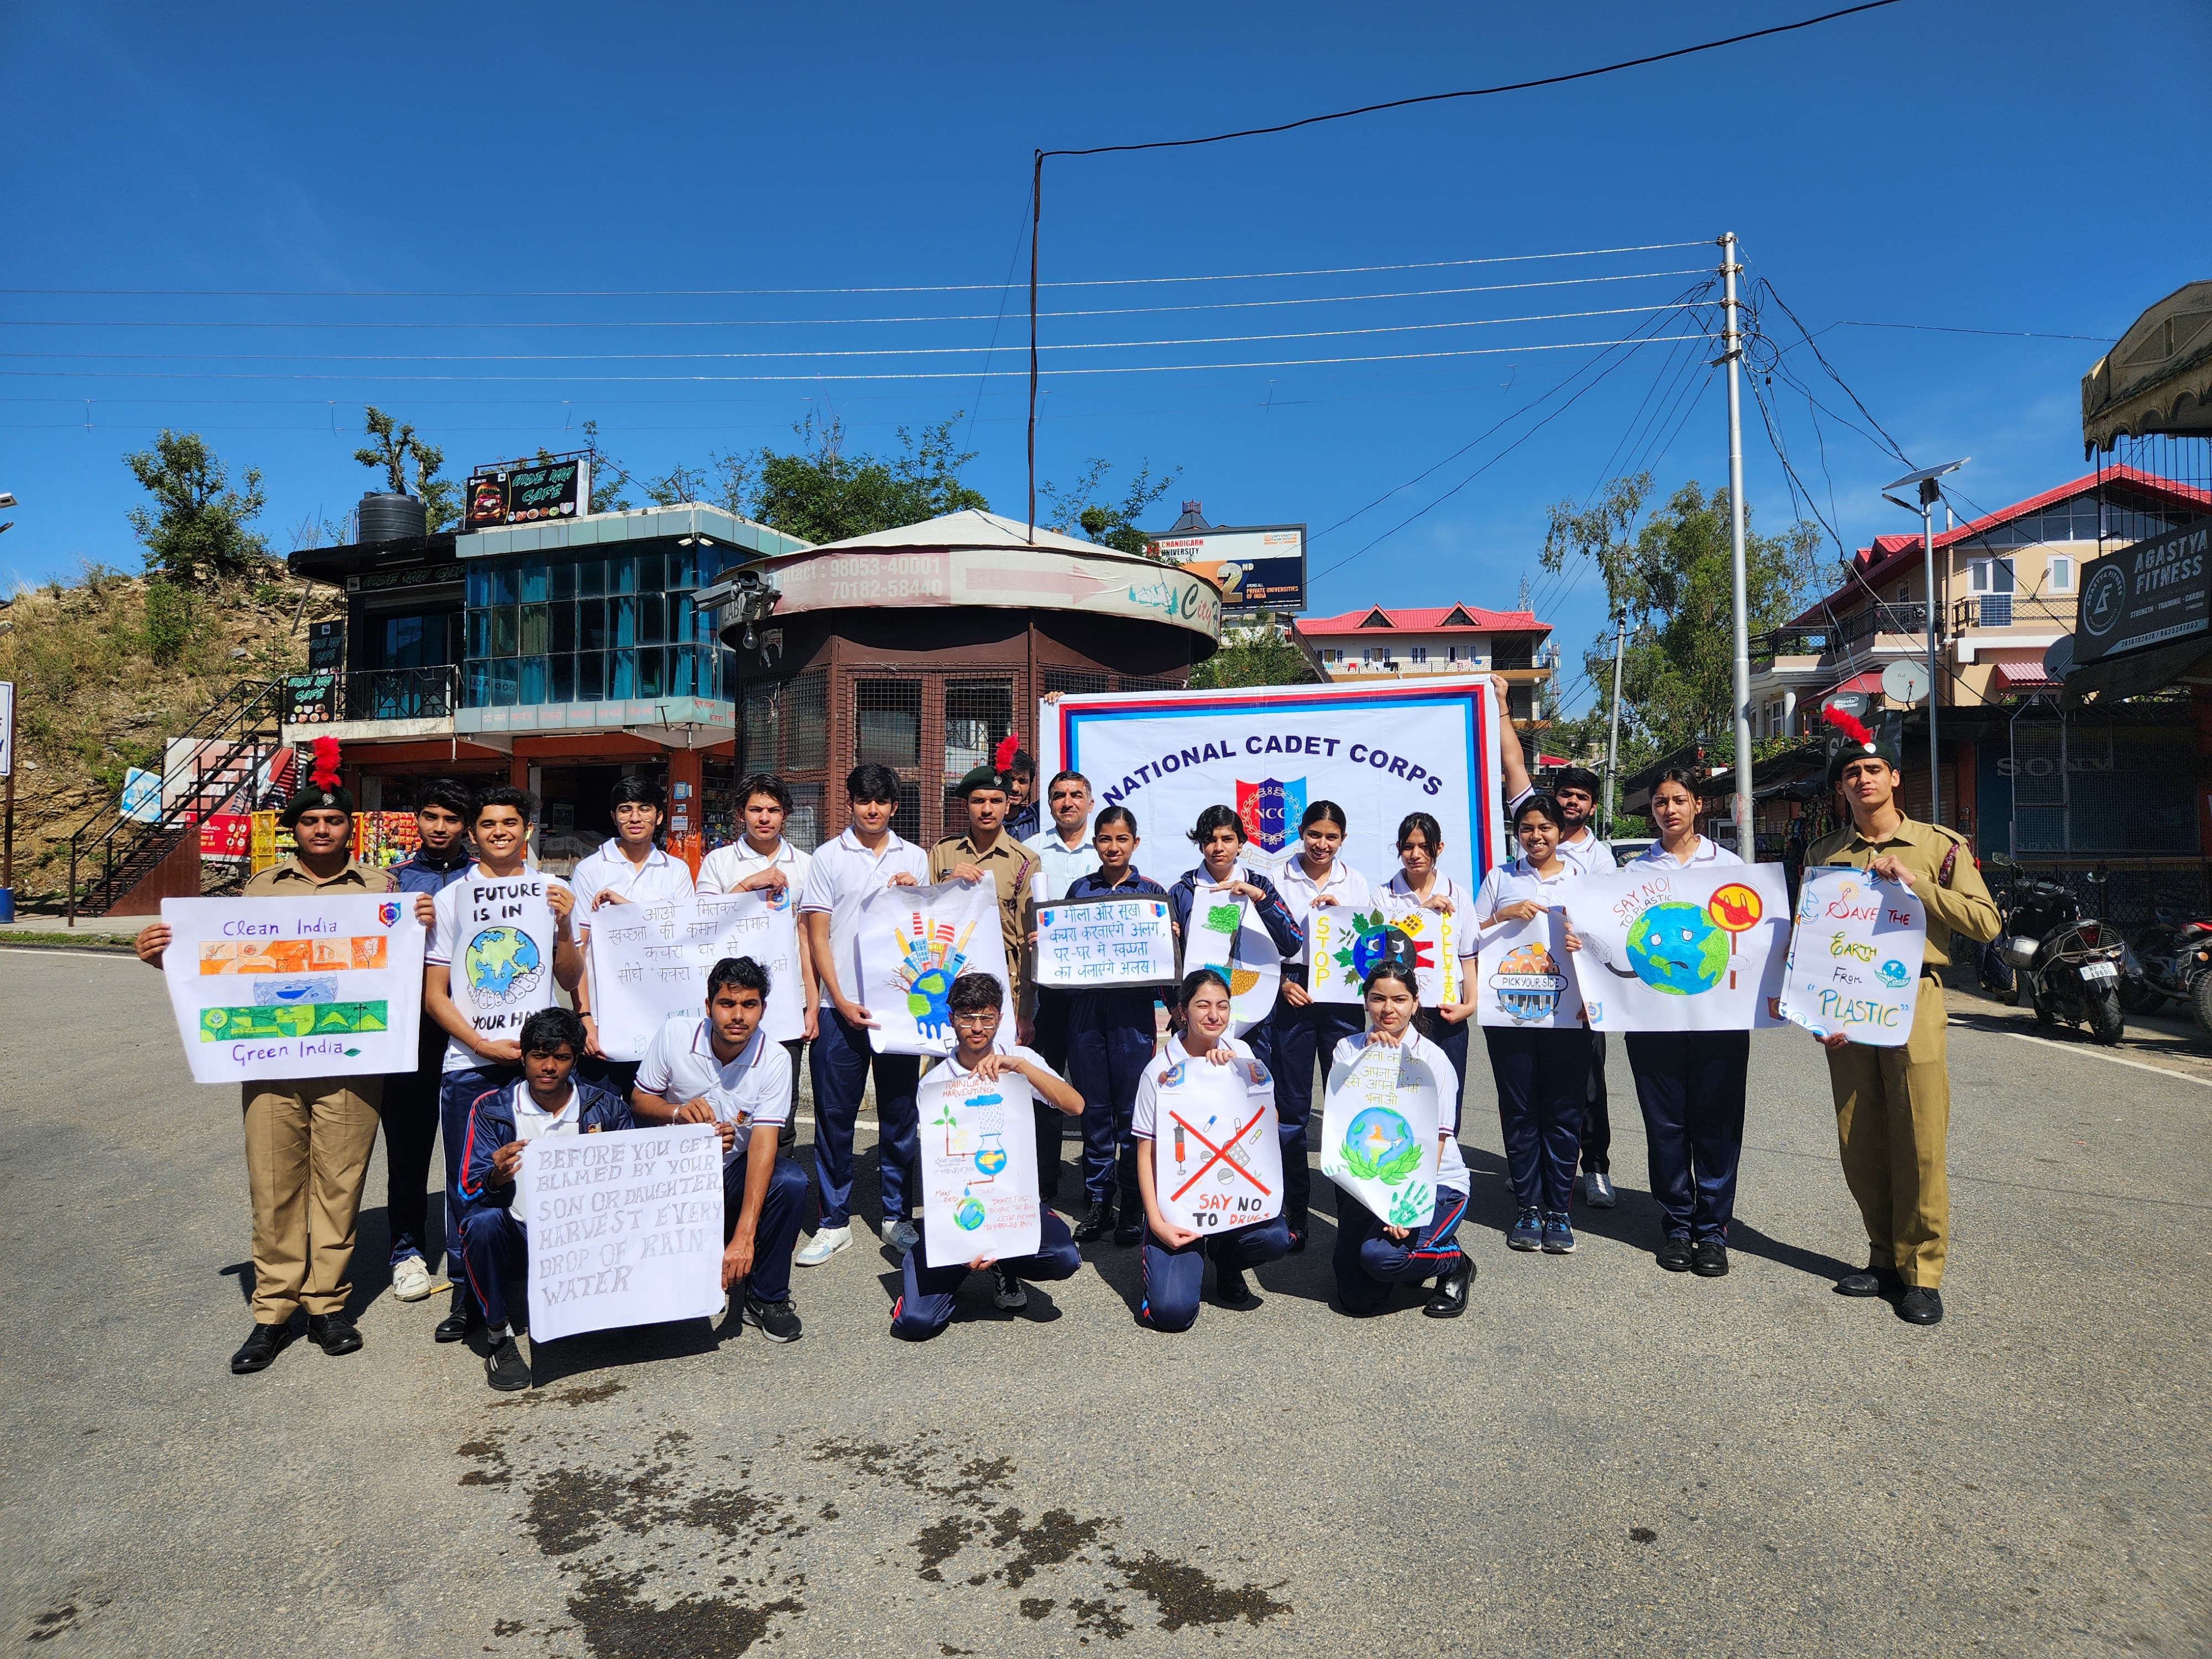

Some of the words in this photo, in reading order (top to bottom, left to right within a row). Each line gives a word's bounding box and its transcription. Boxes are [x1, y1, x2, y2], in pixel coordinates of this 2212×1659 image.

[1161, 547, 1199, 556] UNIVERSITY
[1162, 539, 1204, 548] CHANDIGARH
[2135, 529, 2208, 573] AGASTYA
[435, 565, 466, 582] CAF
[831, 556, 940, 578] 98053-40001
[2136, 555, 2203, 594] FITNESS
[831, 579, 943, 600] 70182-58440
[2130, 605, 2154, 618] STRENGTH
[2158, 598, 2181, 610] TRAINING
[2185, 590, 2205, 602] CARDIO
[1102, 739, 1236, 806] NATIONAL
[1245, 735, 1340, 757] CADET
[1349, 743, 1443, 795] CORPS
[1997, 757, 2114, 776] SONY
[1254, 807, 1288, 820] NCC
[473, 882, 541, 904] FUTURE
[1613, 890, 1640, 918] SAY
[1642, 877, 1671, 896] NO!
[473, 907, 491, 922] IS
[502, 903, 523, 919] IN
[696, 898, 739, 917] मिलकर
[1064, 906, 1090, 923] गीला
[1093, 902, 1114, 921] और
[1118, 904, 1140, 921] सूखा
[1620, 914, 1634, 928] TO
[1633, 894, 1672, 916] PLASTIC
[1887, 909, 1911, 926] THE
[223, 920, 279, 936] Clean
[298, 917, 337, 935] India
[660, 921, 675, 939] की
[686, 921, 719, 939] कमान
[1050, 927, 1076, 943] कचरा
[643, 945, 683, 962] कचरा
[698, 942, 716, 957] घर
[727, 935, 739, 955] से
[1314, 917, 1330, 988] STOP
[1441, 911, 1455, 1004] POLLUTION
[1055, 965, 1072, 979] का
[2091, 970, 2113, 978] A9605
[1503, 977, 1521, 986] PICK
[1521, 977, 1540, 988] YOUR
[1542, 978, 1559, 988] SIDE
[473, 1014, 506, 1030] YOUR
[510, 1010, 538, 1027] HA
[233, 1042, 289, 1066] Green
[300, 1039, 343, 1058] India
[943, 1087, 994, 1098] HARVESTING
[1343, 1074, 1360, 1088] इसे
[1365, 1079, 1395, 1092] अपना
[1401, 1077, 1423, 1094] धर्म
[1365, 1092, 1398, 1105] बनाओ
[538, 1142, 626, 1171] BEFORE
[631, 1139, 671, 1160] YOU
[680, 1136, 717, 1154] GET
[535, 1165, 622, 1193] BLAMED
[631, 1161, 656, 1178] BY
[668, 1155, 716, 1175] YOUR
[538, 1194, 586, 1222] SON
[591, 1190, 620, 1212] OR
[1199, 1193, 1233, 1211] SAY
[1238, 1196, 1262, 1212] NO
[539, 1208, 643, 1251] HARVEST
[655, 1200, 723, 1227] EVERY
[1192, 1212, 1218, 1227] TO
[1229, 1213, 1270, 1225] DRUGS
[540, 1248, 591, 1279] DROP
[599, 1238, 627, 1267] OF
[640, 1227, 705, 1260] RAIN
[541, 1265, 633, 1307] WATER
